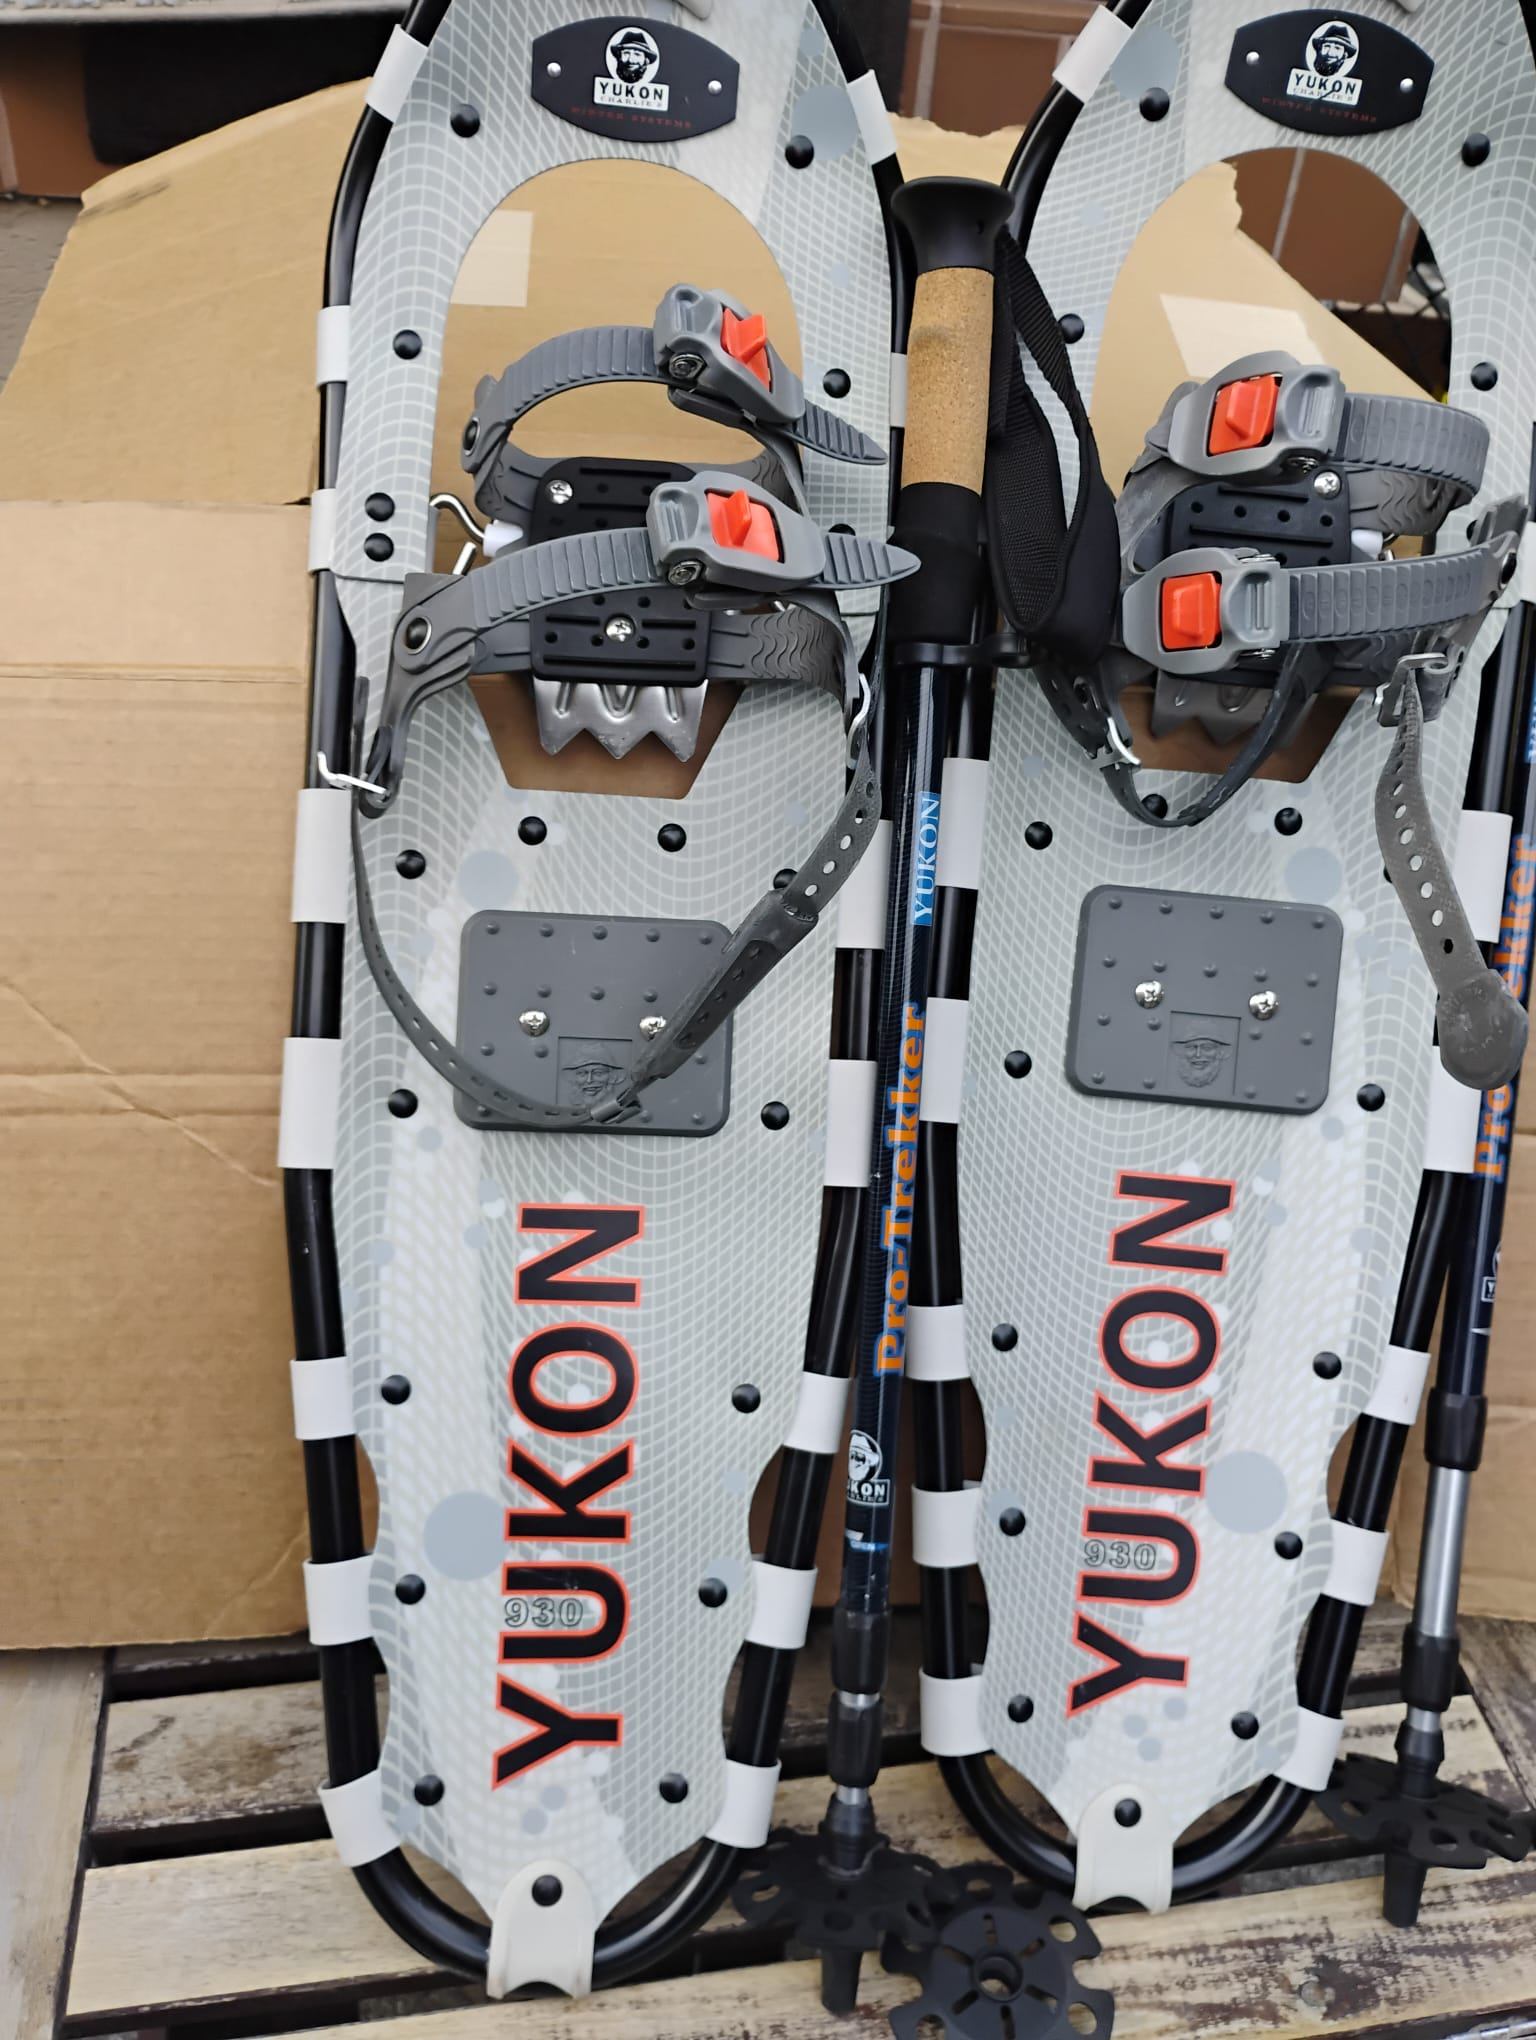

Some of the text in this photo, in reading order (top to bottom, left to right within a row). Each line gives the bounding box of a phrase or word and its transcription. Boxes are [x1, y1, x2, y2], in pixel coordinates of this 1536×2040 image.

[600, 82, 663, 101] YUKON
[1295, 74, 1356, 94] YUKON
[914, 797, 940, 924] YUKON
[874, 1004, 925, 1374] Pro-Trekker
[1065, 1169, 1236, 1718] YUKON
[491, 1202, 644, 1791] YUKON
[848, 1481, 886, 1497] KON
[1084, 1539, 1157, 1571] 930
[503, 1596, 584, 1628] 930
